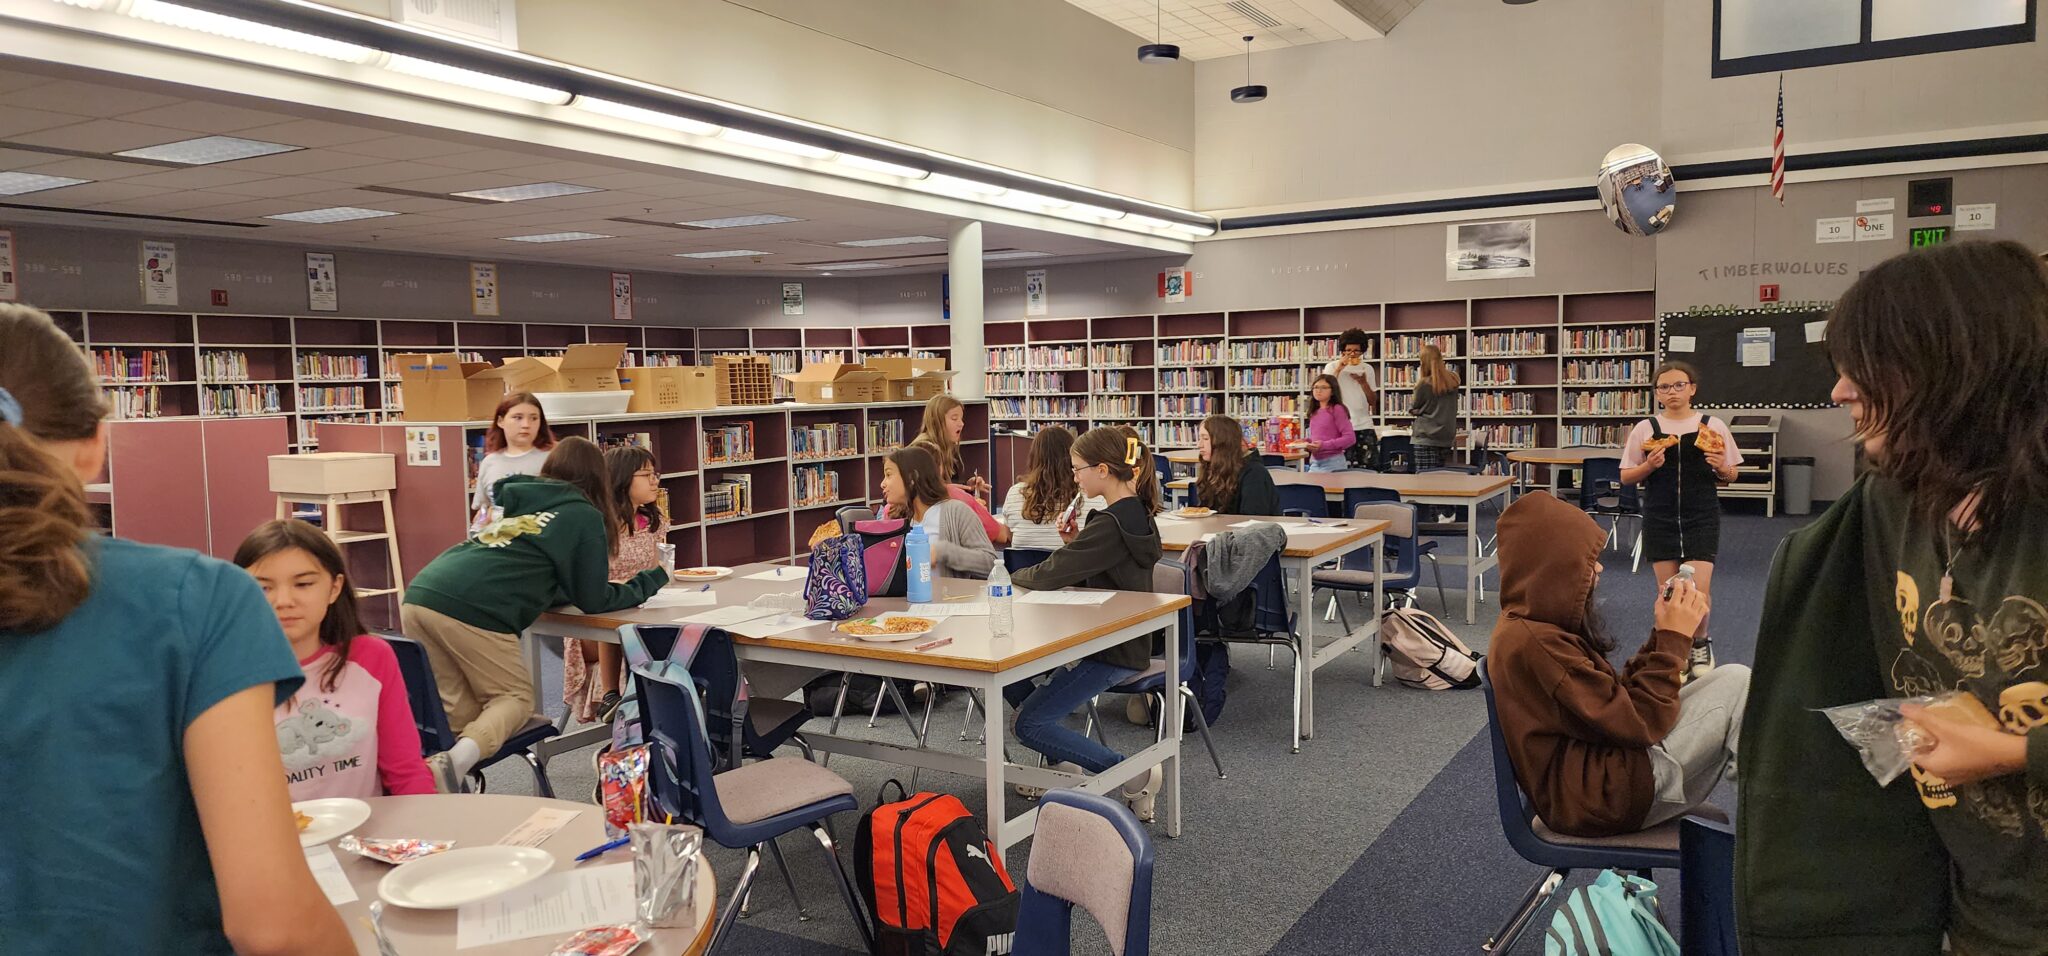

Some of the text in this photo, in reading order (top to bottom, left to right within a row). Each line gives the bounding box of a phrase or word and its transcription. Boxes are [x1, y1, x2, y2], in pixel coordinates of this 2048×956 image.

[1968, 213, 1982, 221] 10
[1829, 226, 1841, 234] 10
[1864, 223, 1884, 232] ONE
[1913, 229, 1945, 248] EXIT
[1699, 262, 1848, 281] TIMBERWOLVES
[1689, 303, 1739, 317] BOOK
[333, 755, 362, 773] TIME
